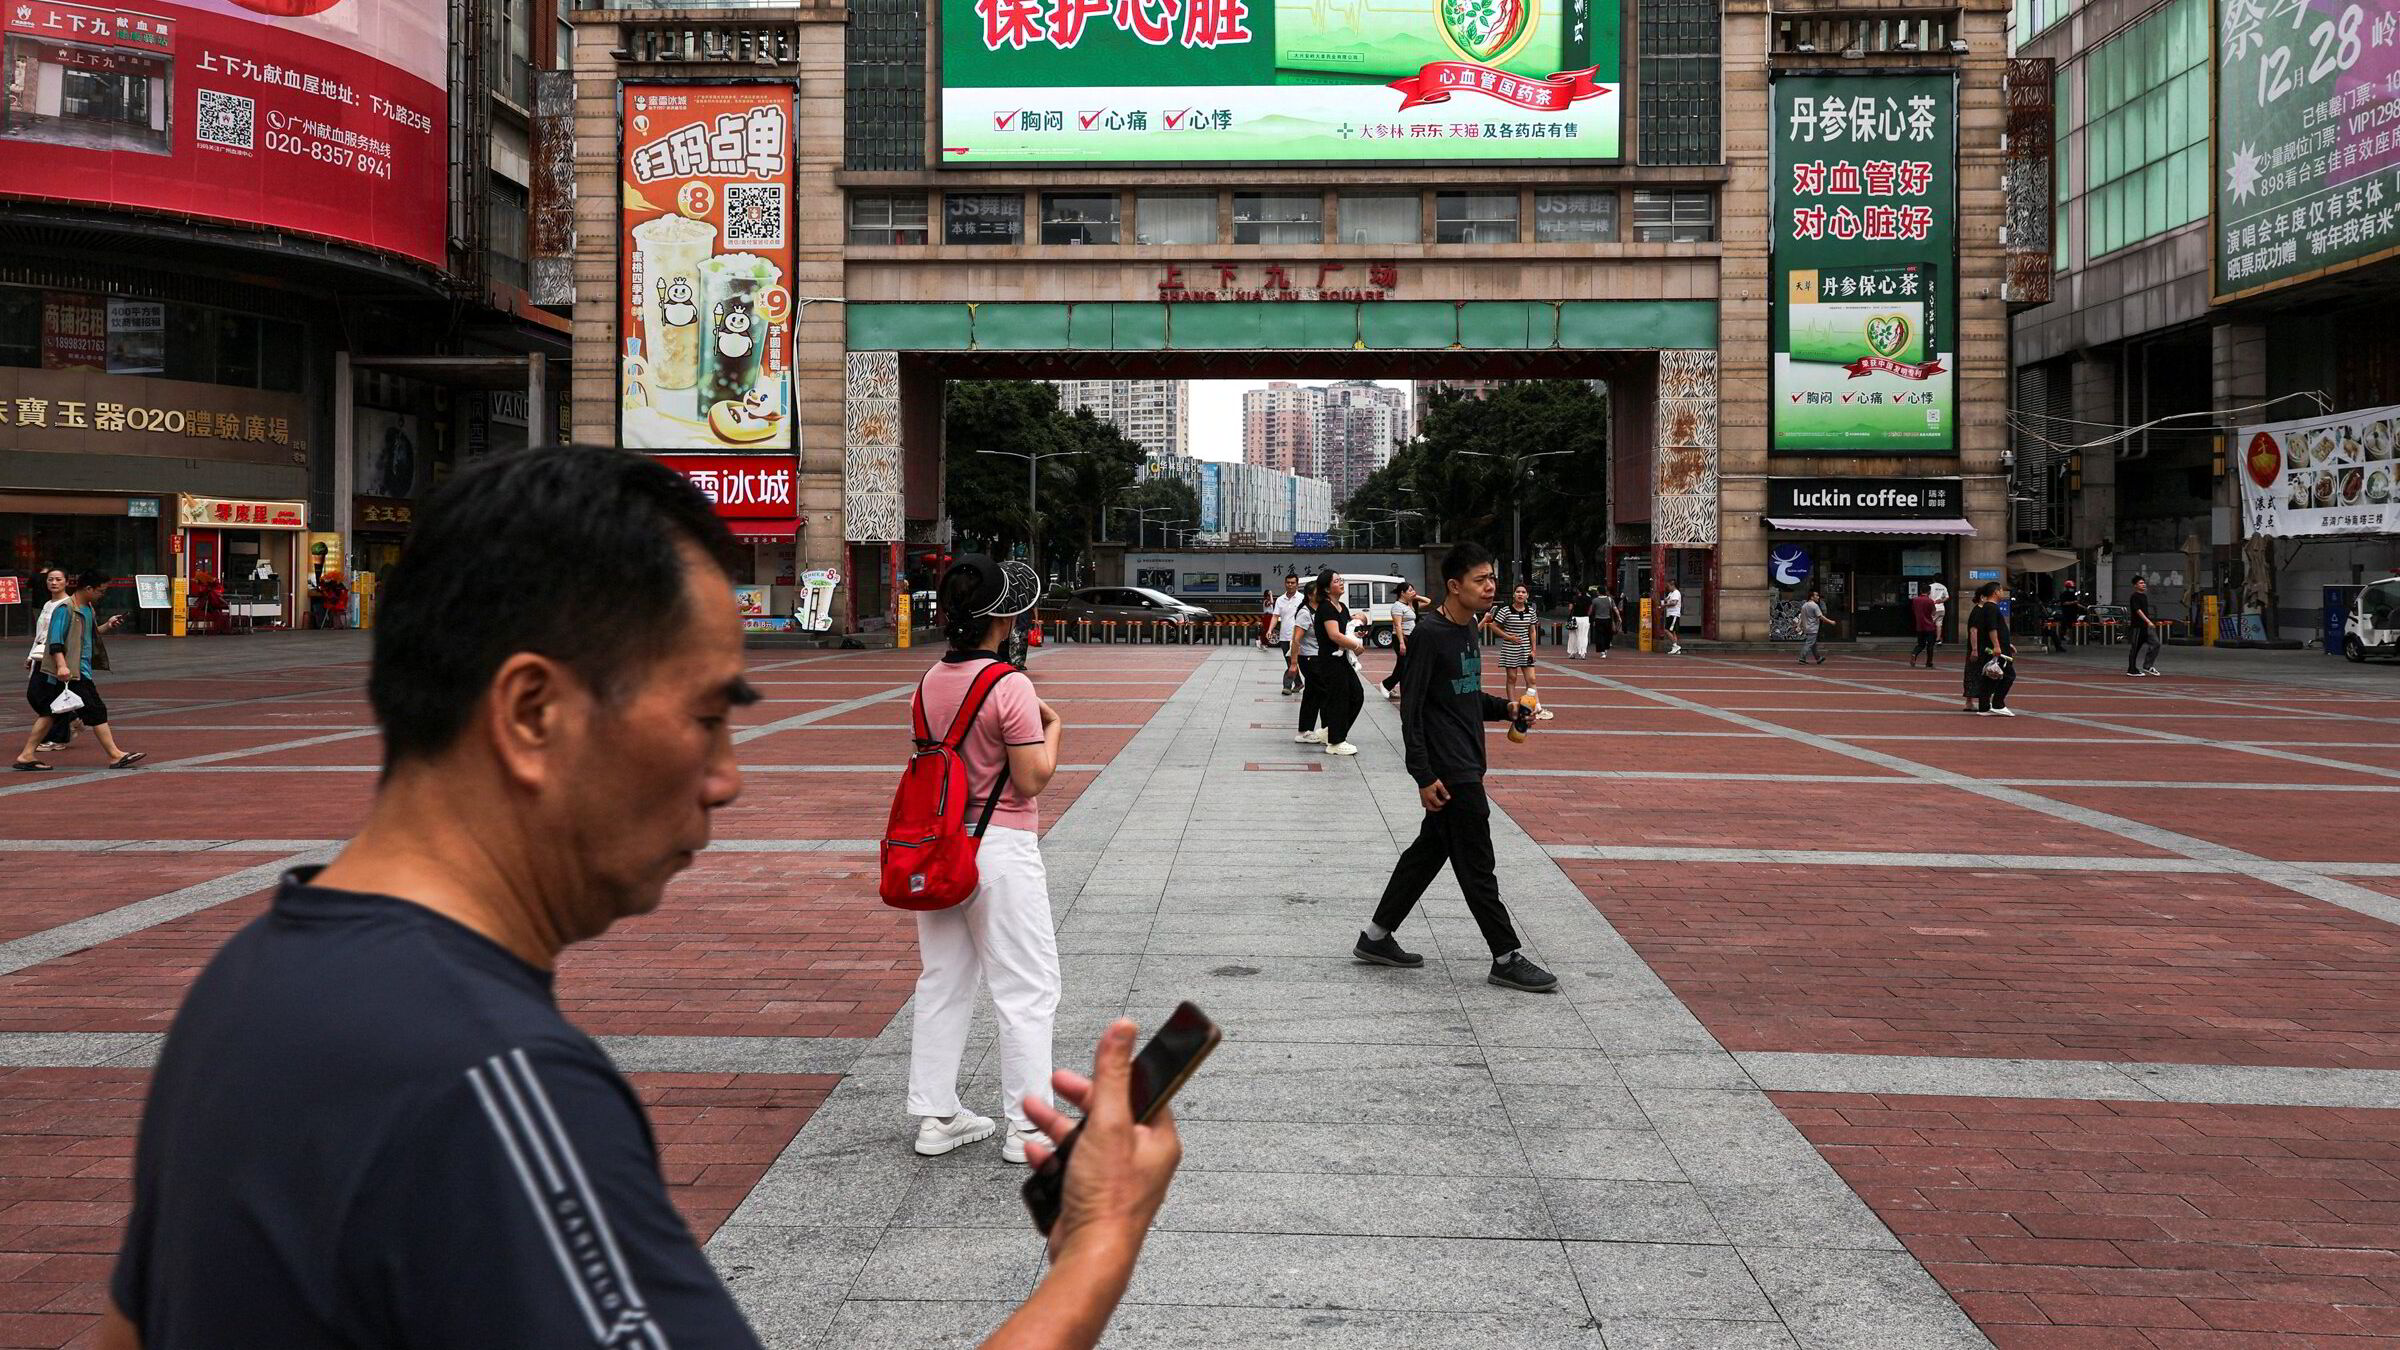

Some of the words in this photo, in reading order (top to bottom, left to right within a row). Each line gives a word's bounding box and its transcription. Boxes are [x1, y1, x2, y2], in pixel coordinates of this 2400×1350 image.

[42, 11, 111, 36] 上下九
[1439, 67, 1553, 105] 心血管国药茶
[1020, 110, 1064, 131] 胸闷
[1104, 110, 1148, 131] 心痛
[1188, 109, 1233, 131] 心悸
[1359, 124, 1404, 139] 大参林
[1410, 124, 1443, 139] 京东
[1448, 123, 1479, 138] 天猫
[1482, 122, 1579, 139] 及各药店有售
[1789, 95, 1936, 143] 丹参保心茶
[286, 115, 391, 160] 广州献血服务热线
[636, 109, 783, 177] 扫码点单
[265, 130, 353, 168] 020-8357
[357, 154, 392, 180] 8941
[1793, 160, 1933, 196] 对血管好
[689, 187, 710, 214] 8
[1793, 205, 1933, 241] 对心脏好
[1158, 264, 1398, 290] 上下九广场
[1822, 273, 1920, 297] 丹参保心茶
[767, 290, 789, 317] 9
[1159, 290, 1217, 301] SHANG
[1318, 290, 1385, 301] SQUARE
[1806, 391, 1833, 404] 胸闷
[1857, 391, 1883, 404] 心痛
[1907, 391, 1934, 404] 心悸
[1793, 488, 1851, 507] luckin
[1856, 488, 1919, 507] coffee
[1928, 489, 1947, 498] 瑞幸
[1928, 499, 1947, 508] 咖啡
